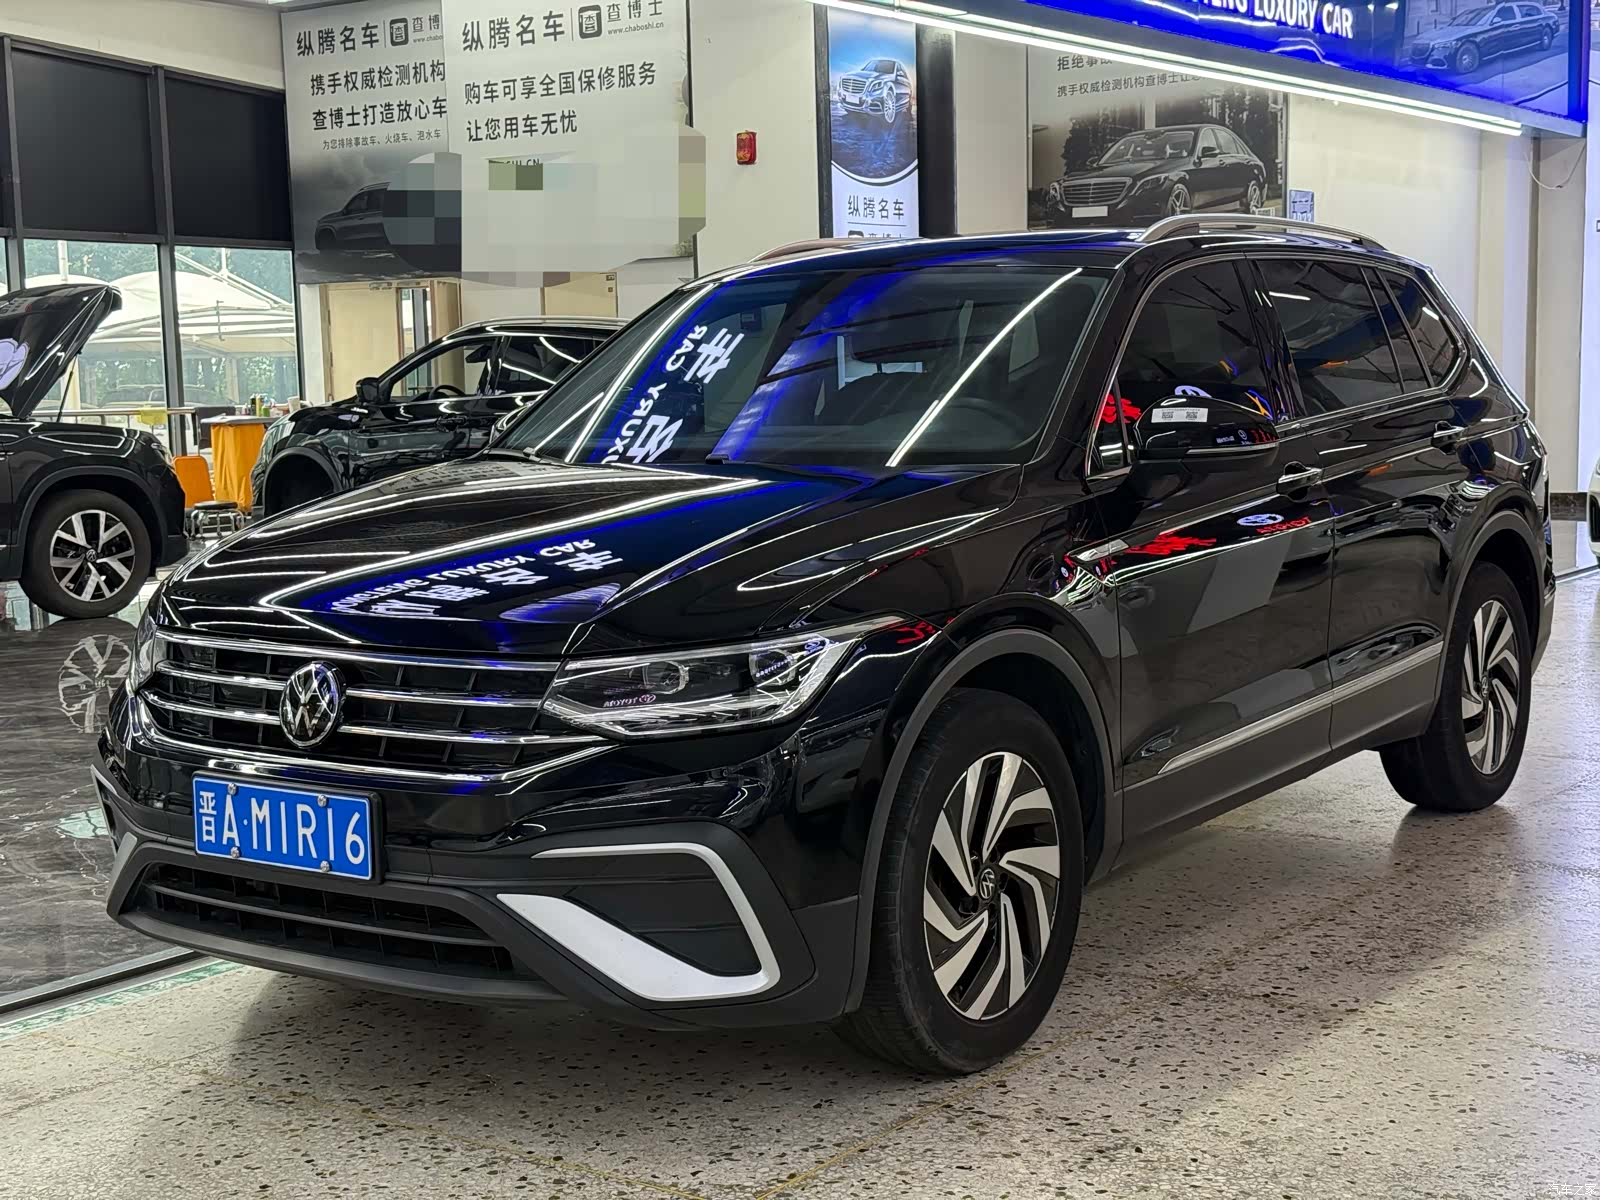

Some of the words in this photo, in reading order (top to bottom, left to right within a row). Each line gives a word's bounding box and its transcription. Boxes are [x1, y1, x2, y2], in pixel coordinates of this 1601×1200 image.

[462, 10, 565, 51] 纵腾名车
[606, 0, 663, 22] 查博士
[607, 22, 664, 35] www.chaboshi.cn
[1322, 3, 1354, 39] CAR
[296, 22, 380, 57] 纵腾名车
[310, 59, 446, 96] 携手权威检测机构
[464, 61, 657, 105] 购车可享全国保修服务
[312, 96, 448, 131] 查博士打造放心车
[466, 109, 578, 142] 让您用车无忧
[847, 195, 905, 220] 纵腾名车
